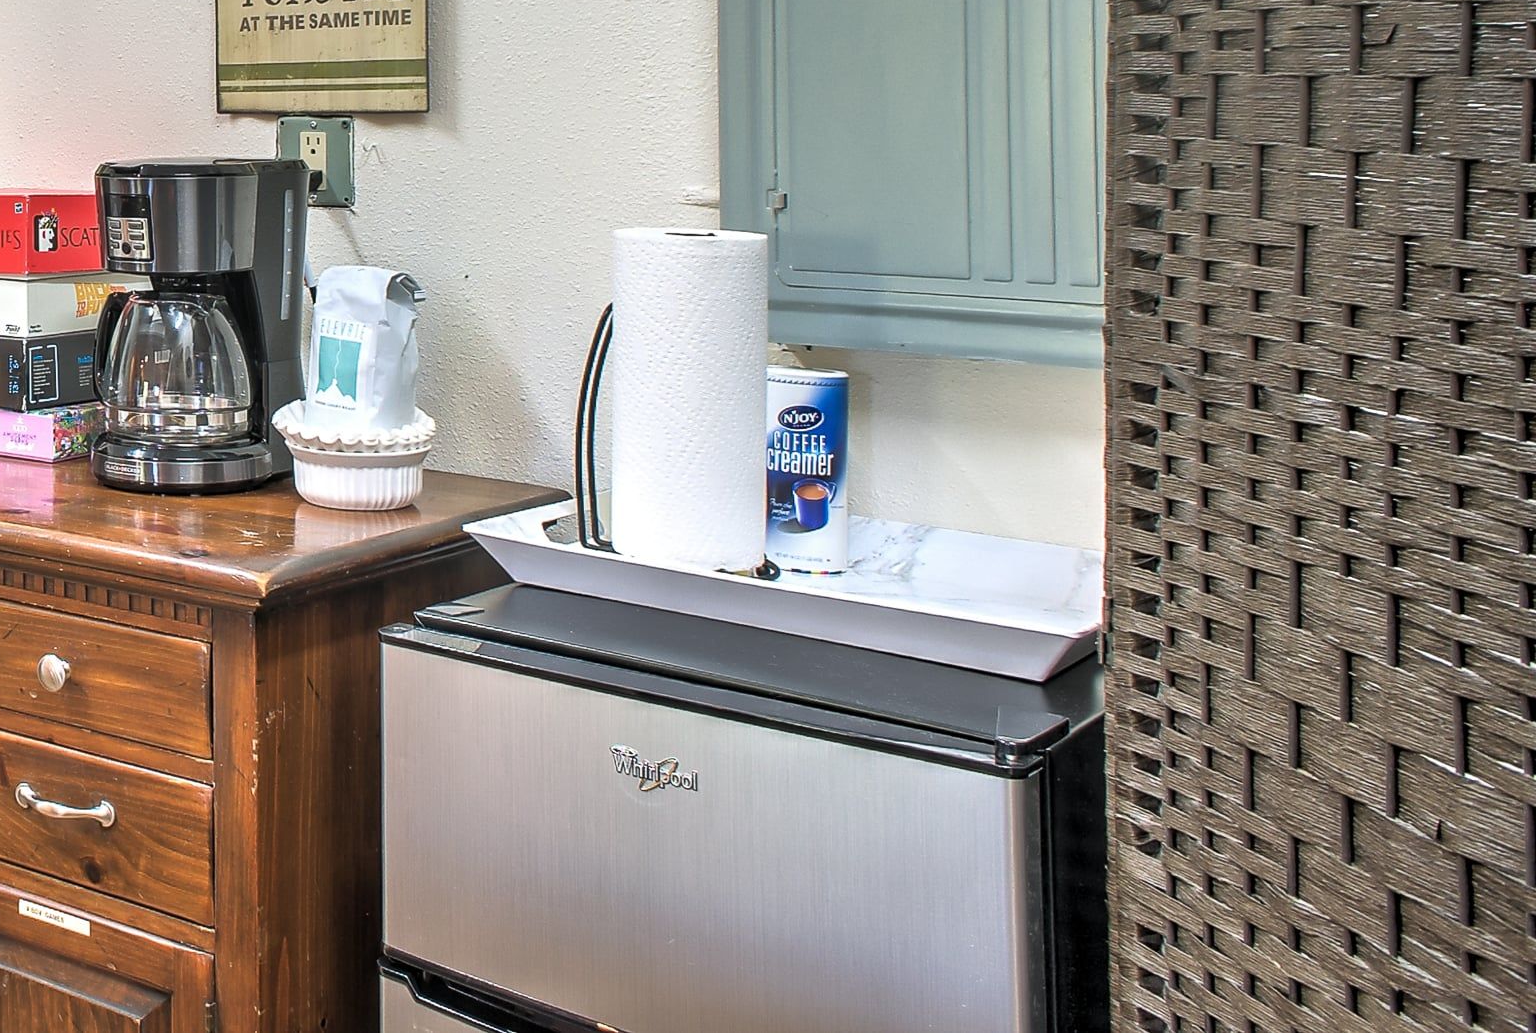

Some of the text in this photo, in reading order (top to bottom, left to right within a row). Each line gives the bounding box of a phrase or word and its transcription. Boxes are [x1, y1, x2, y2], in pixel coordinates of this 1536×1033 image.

[239, 9, 412, 32] AT THE SAME TIME
[773, 430, 826, 454] COFFEE
[767, 448, 834, 476] creamer
[613, 751, 698, 792] Whirlpool
